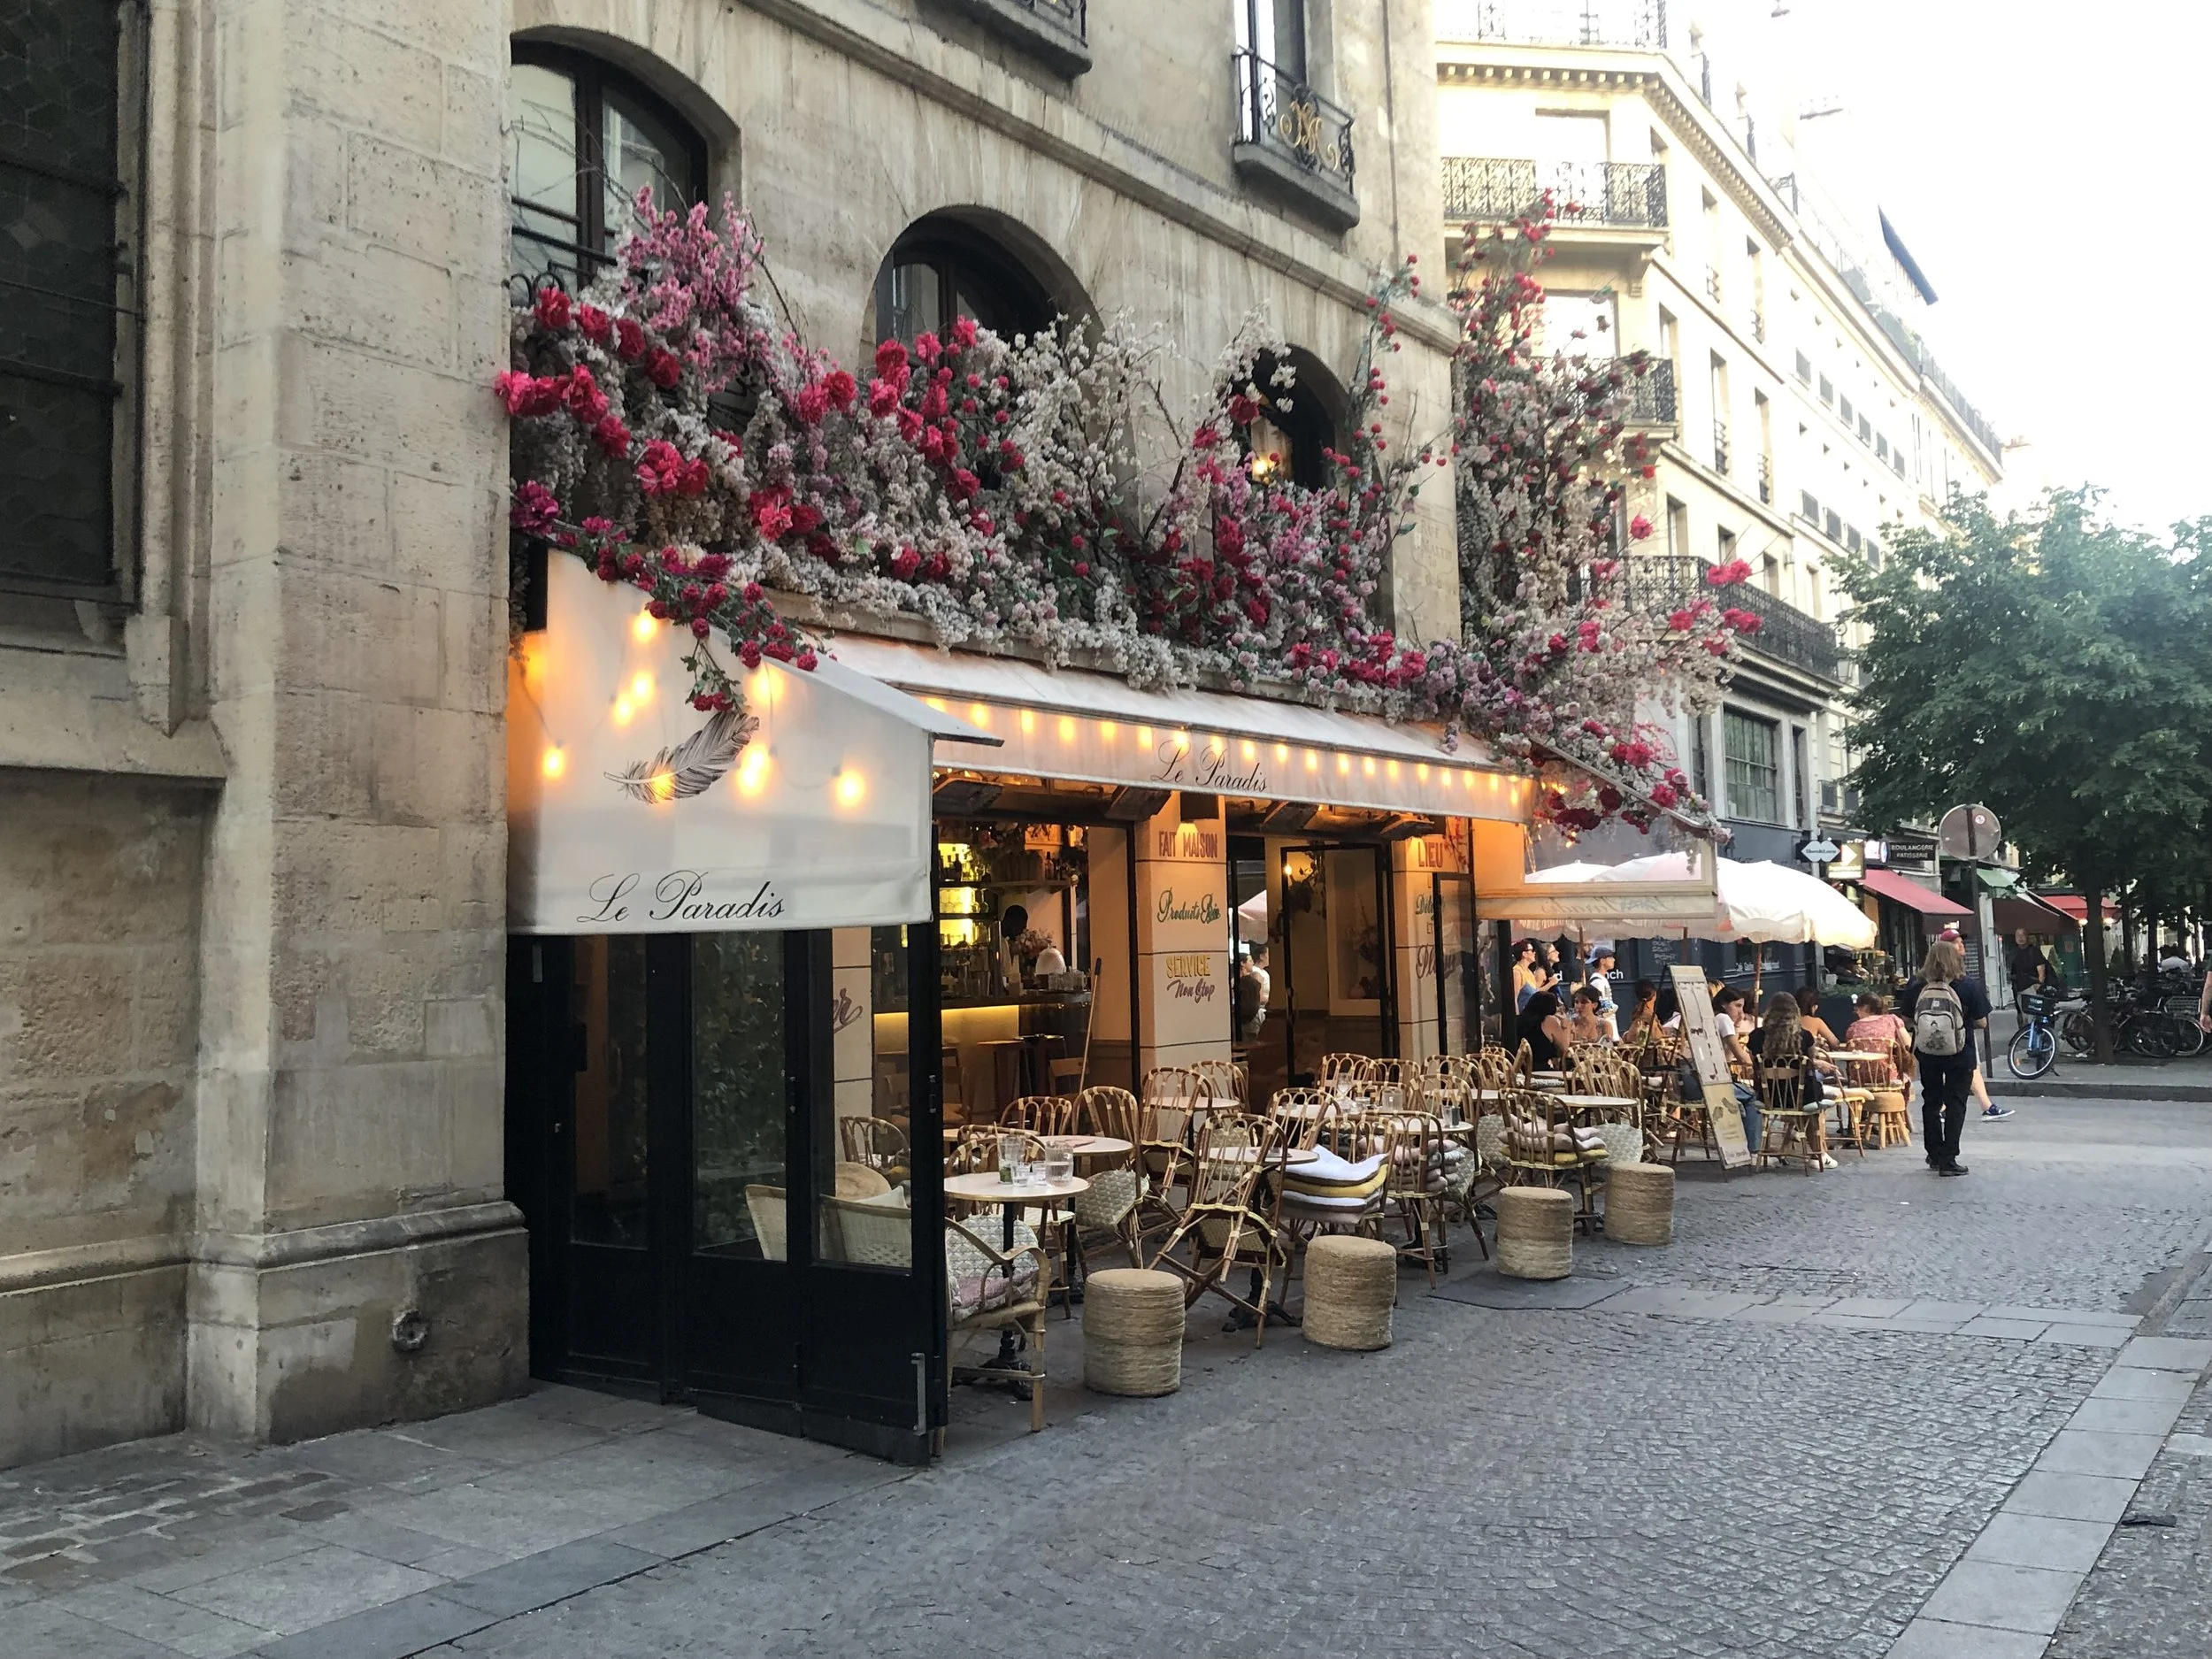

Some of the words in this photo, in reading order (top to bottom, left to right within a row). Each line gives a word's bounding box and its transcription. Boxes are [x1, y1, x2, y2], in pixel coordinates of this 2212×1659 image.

[1150, 740, 1191, 783] Le
[1195, 744, 1268, 793] Paradis
[1158, 831, 1178, 857] FAIT
[1183, 832, 1217, 858] MAISON
[1417, 841, 1444, 868] LIEU
[576, 872, 641, 922] Le
[649, 870, 785, 920] Paradis
[1157, 887, 1201, 923] Produits
[1165, 955, 1210, 979] SERVICE
[1166, 979, 1194, 998] Non
[1194, 978, 1216, 1003] Stop
